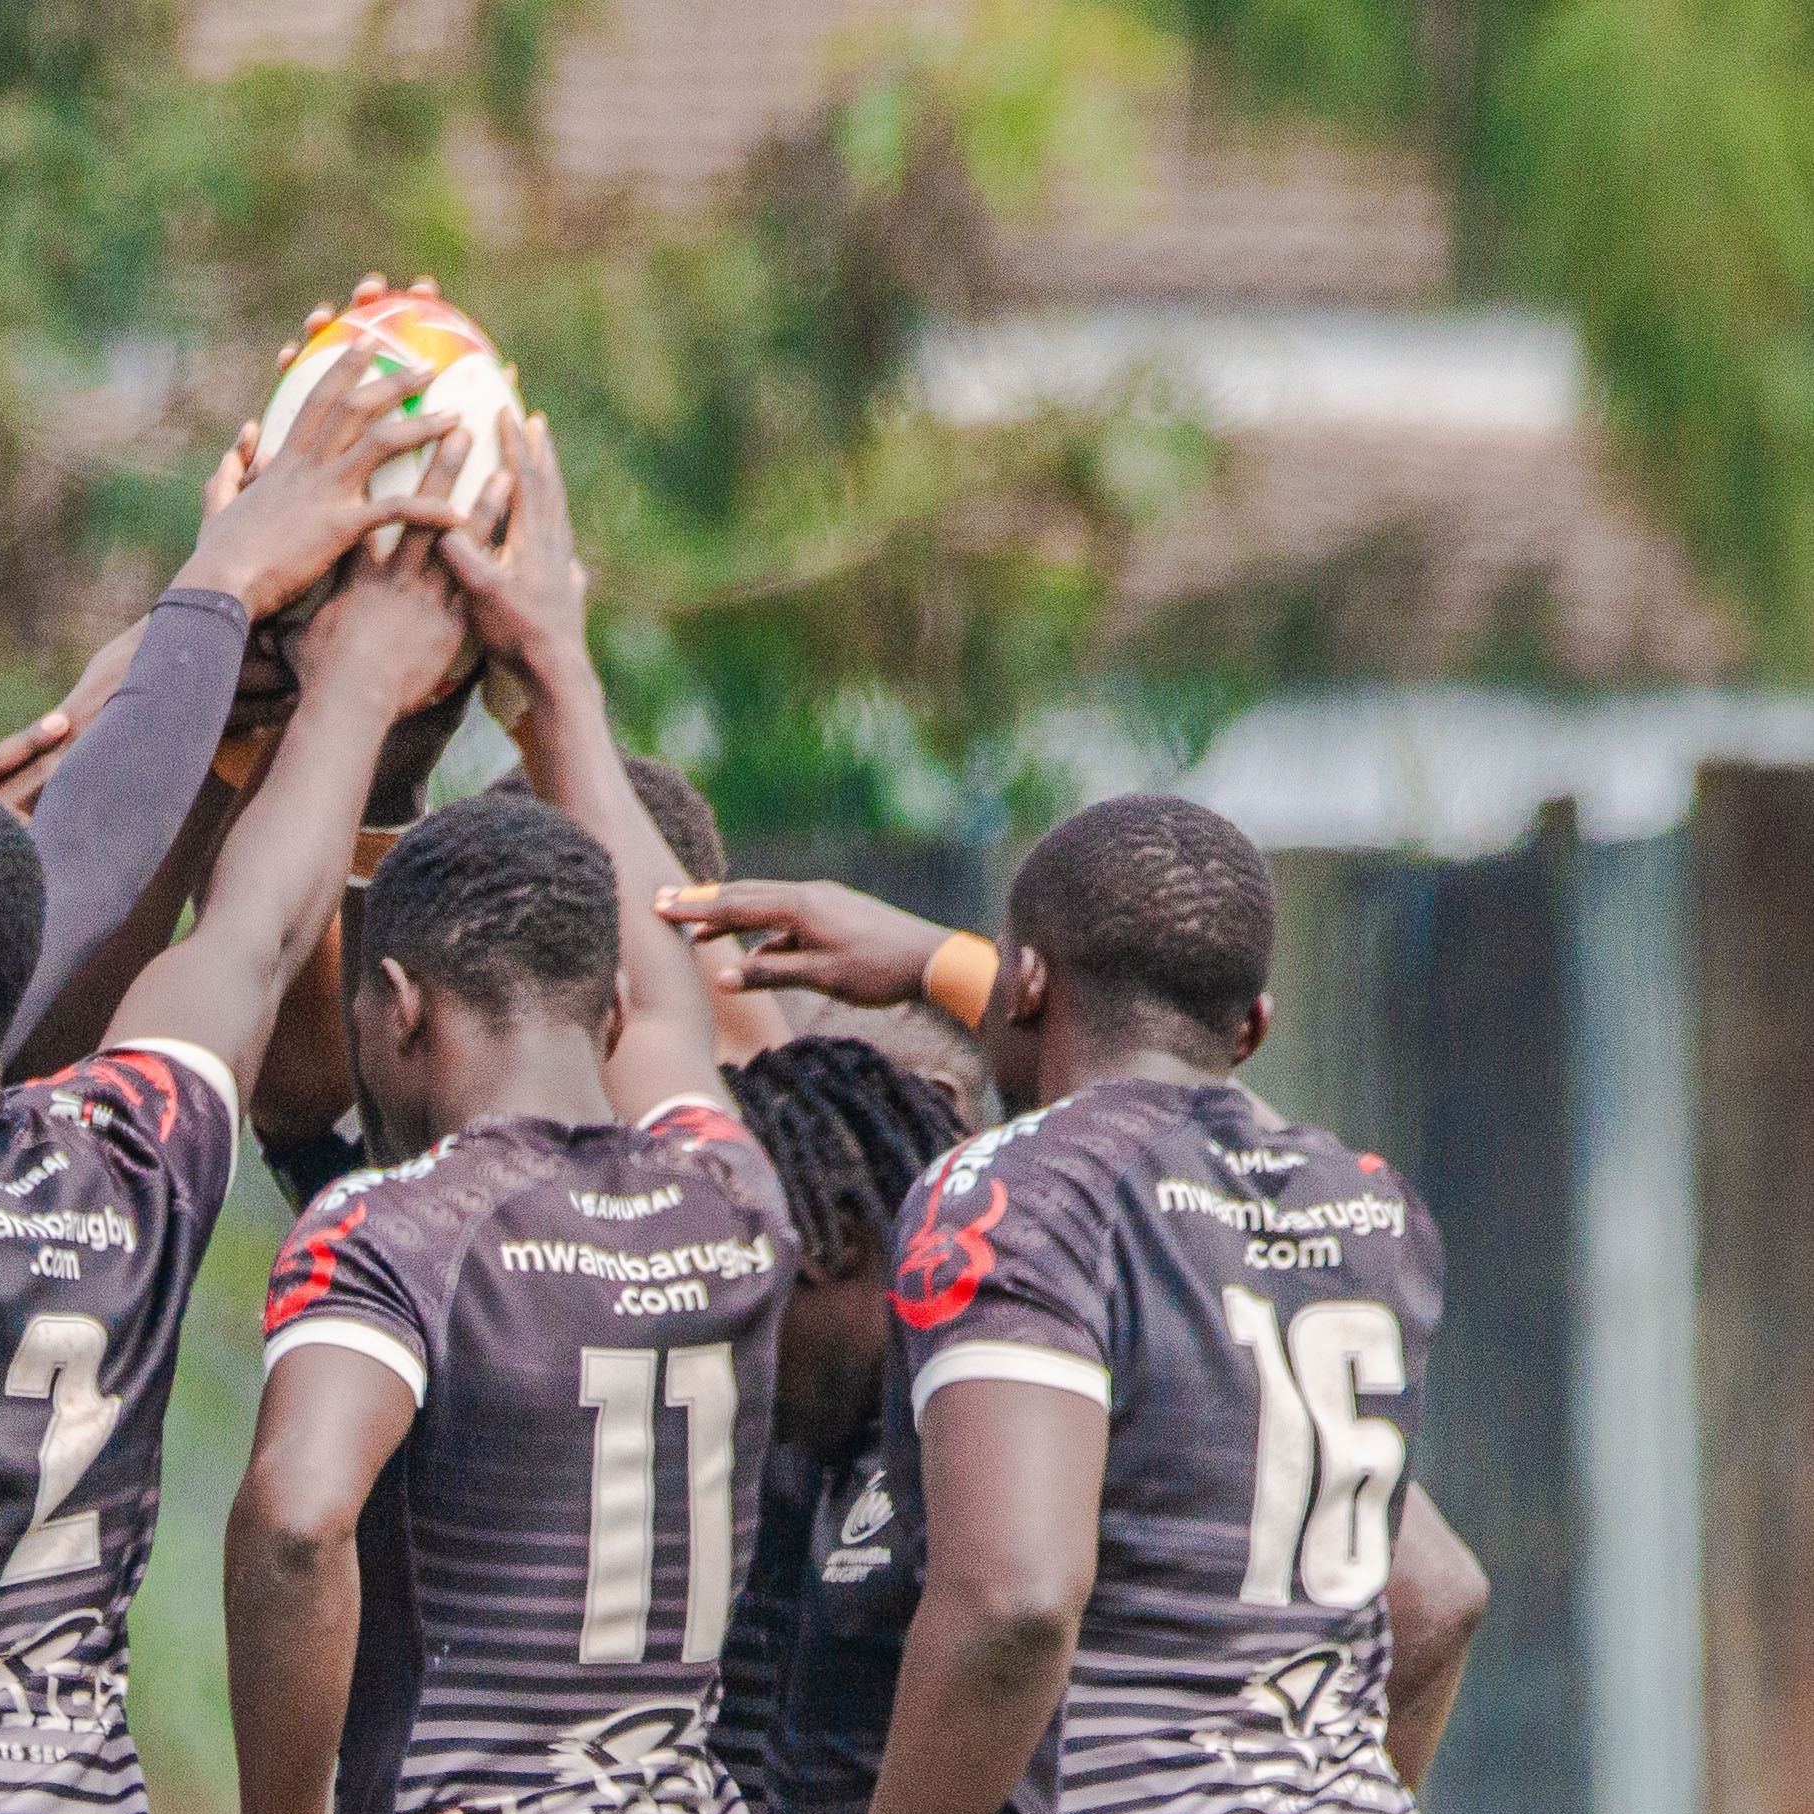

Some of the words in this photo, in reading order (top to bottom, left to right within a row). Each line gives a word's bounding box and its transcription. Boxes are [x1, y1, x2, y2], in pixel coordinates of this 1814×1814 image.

[613, 1278, 710, 1317] .com
[1222, 1284, 1408, 1608] 16
[0, 1314, 122, 1587] 2
[578, 1341, 738, 1664] 11
